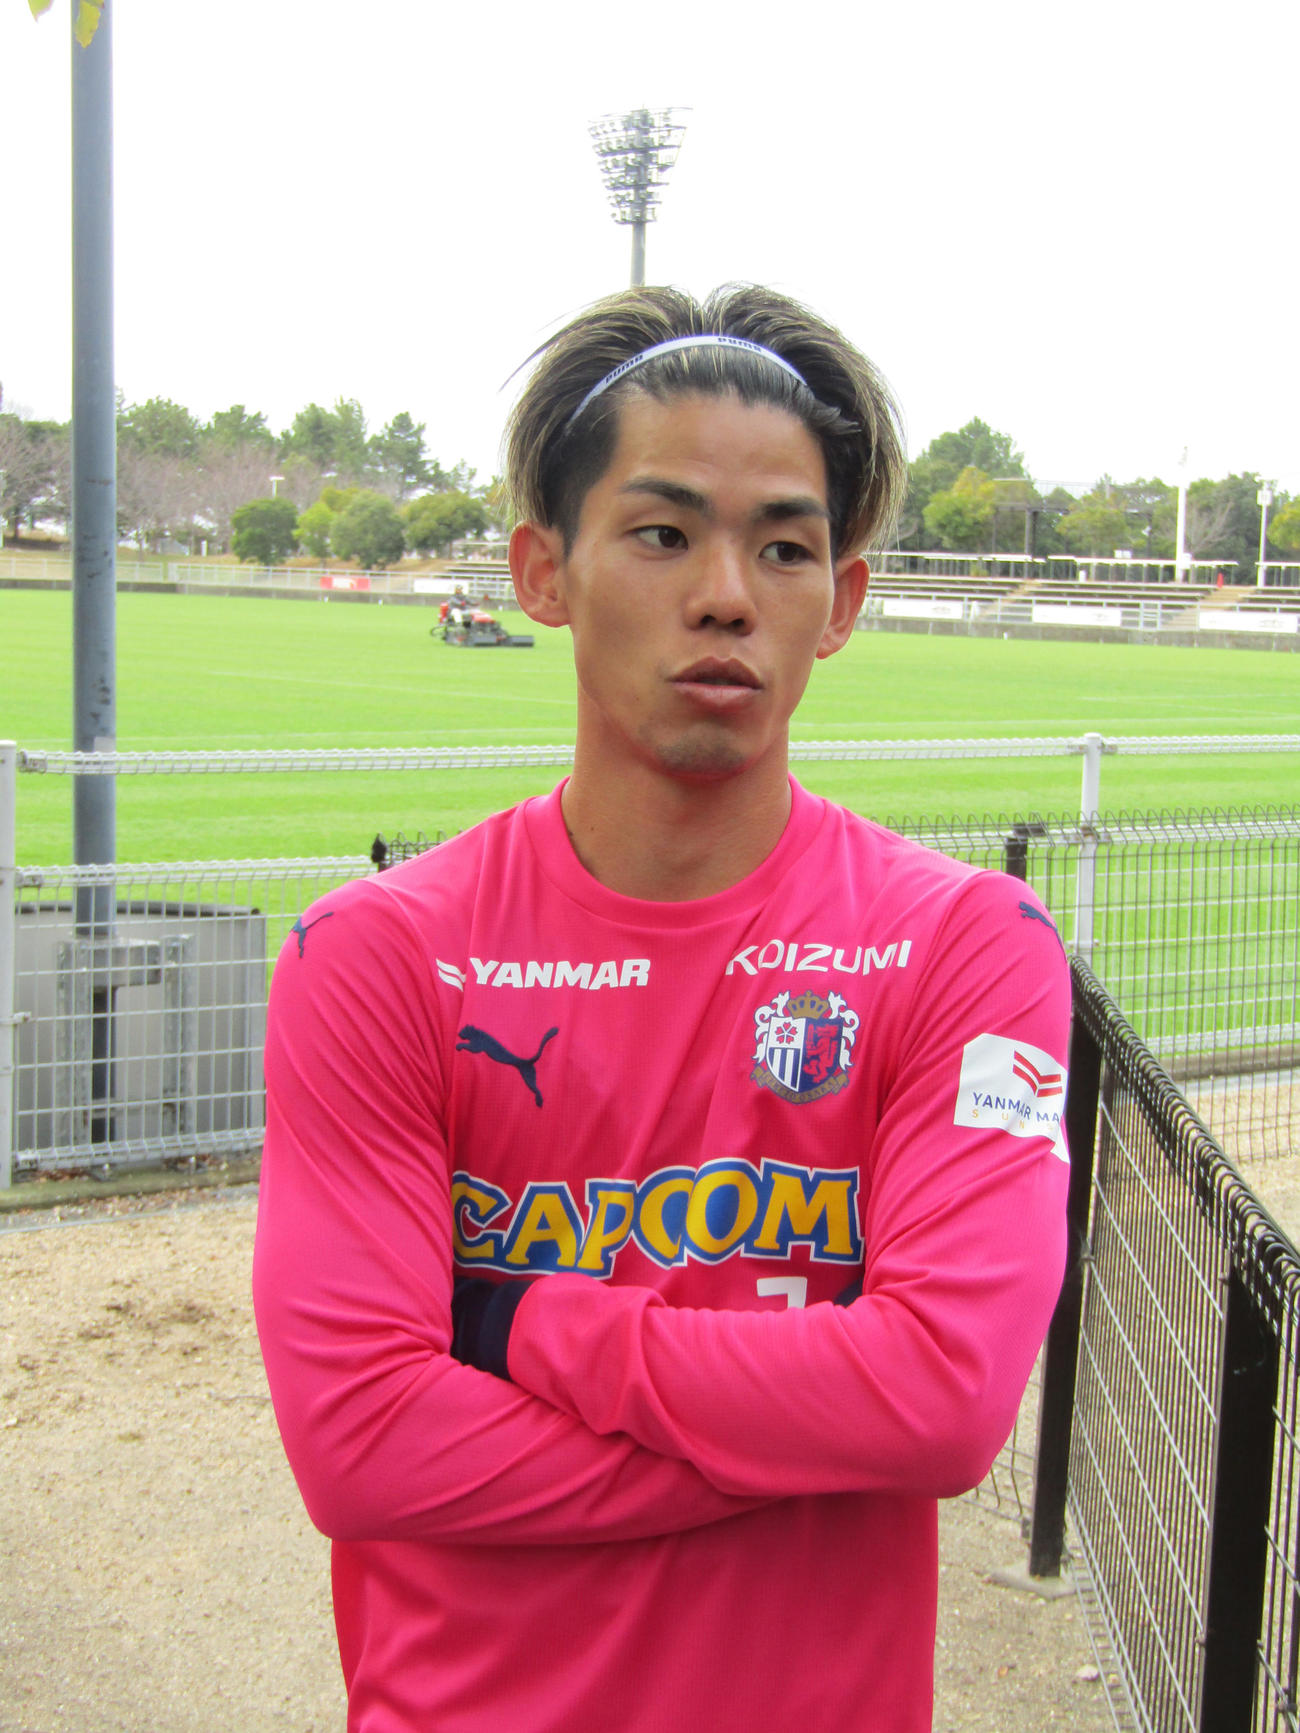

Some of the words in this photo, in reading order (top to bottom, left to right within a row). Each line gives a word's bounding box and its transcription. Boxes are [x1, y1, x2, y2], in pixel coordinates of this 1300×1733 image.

[469, 957, 652, 990] YANMAR
[725, 939, 912, 977] KOIZUMI
[972, 1091, 1032, 1120] YANMAR
[452, 1157, 865, 1280] CAPCOM
